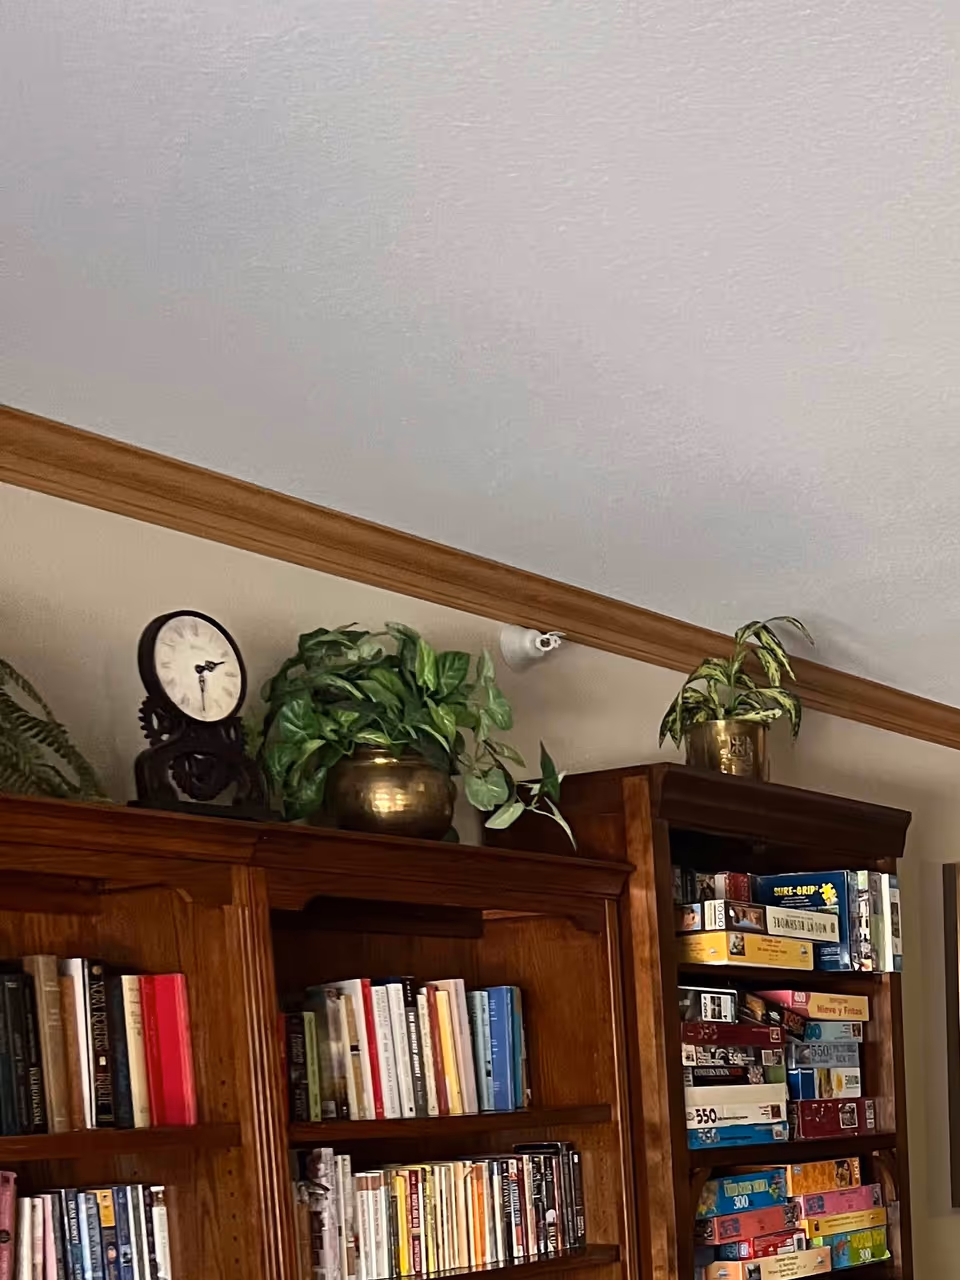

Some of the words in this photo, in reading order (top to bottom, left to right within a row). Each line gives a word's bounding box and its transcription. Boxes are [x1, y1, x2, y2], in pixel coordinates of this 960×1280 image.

[773, 917, 804, 931] RUSHMORE
[807, 922, 827, 933] MOUNT
[90, 981, 106, 1008] NORA
[91, 1012, 109, 1050] ROBERTS
[811, 1045, 828, 1057] 550
[95, 1073, 113, 1105] TRIBUTE
[695, 1109, 717, 1124] 550
[68, 1200, 76, 1218] DEAN
[733, 1195, 748, 1209] 300
[69, 1218, 79, 1243] KOONTZ
[859, 1248, 871, 1261] 300
